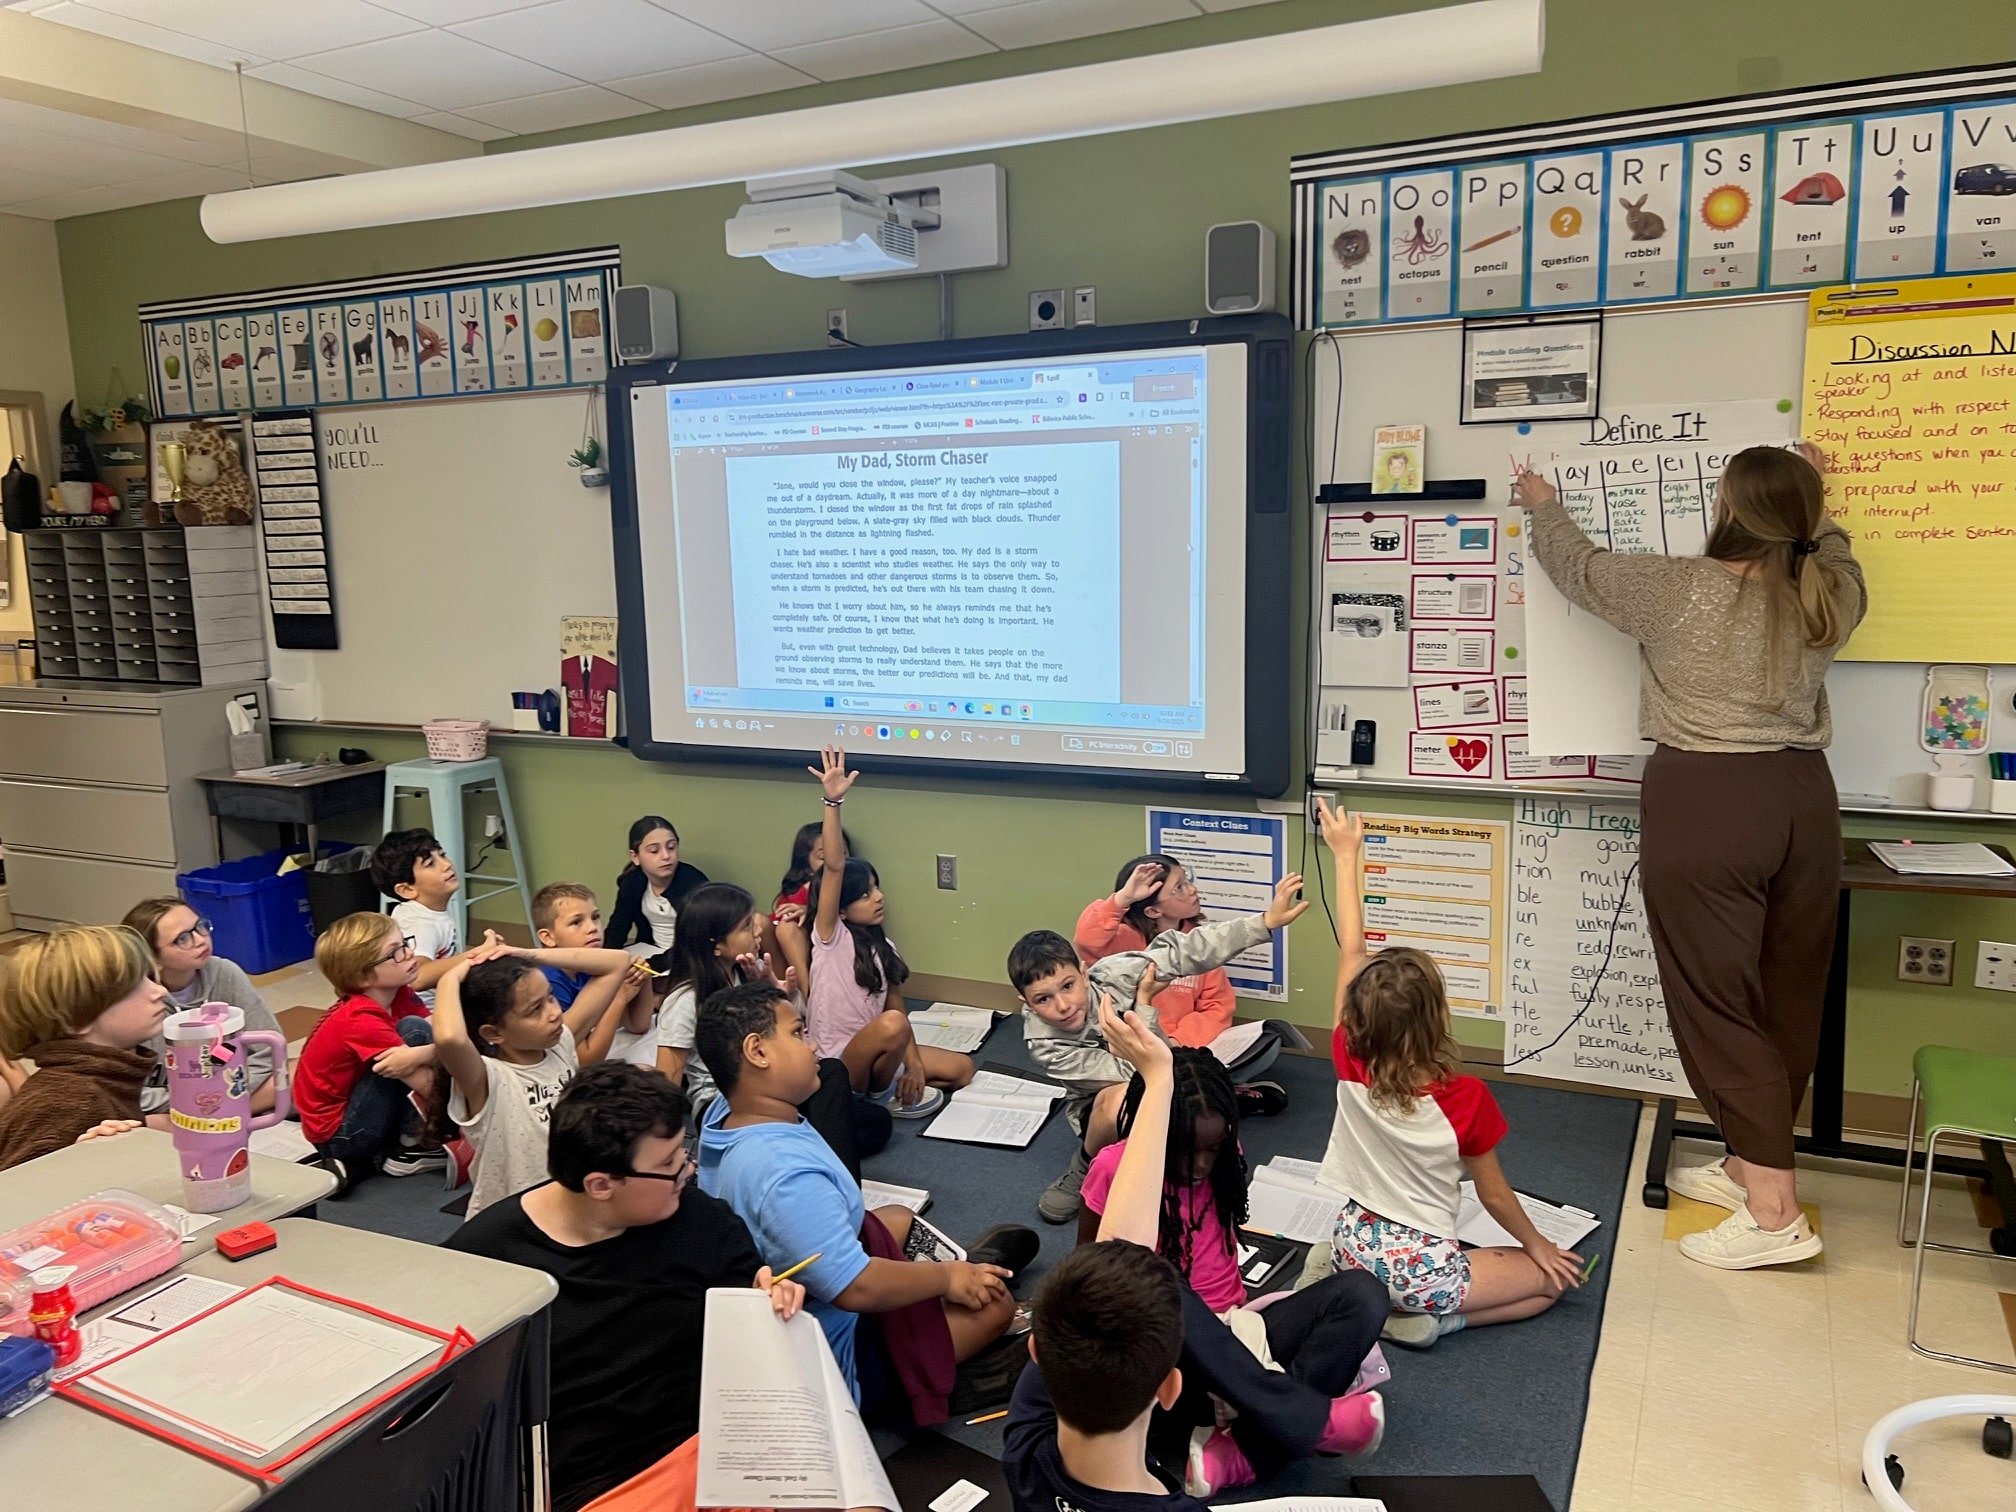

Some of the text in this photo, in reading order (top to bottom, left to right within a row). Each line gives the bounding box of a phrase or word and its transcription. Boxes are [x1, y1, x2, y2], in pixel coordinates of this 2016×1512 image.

[1889, 224, 1906, 234] up
[1976, 216, 2000, 226] van
[1796, 231, 1821, 242] tent
[1624, 247, 1661, 258] rabbit
[1714, 240, 1734, 250] sun
[1474, 262, 1508, 274] pencil
[1541, 254, 1589, 268] question
[1341, 276, 1362, 286] nest
[1399, 269, 1441, 280] octopus
[1849, 335, 1972, 361] Discussion
[1824, 364, 2016, 400] Looking at and liste
[1814, 386, 1870, 403] speaker
[1817, 400, 2011, 428] Responding with respect
[325, 422, 380, 446] YOU'LL
[1588, 412, 1707, 443] Define It
[1814, 429, 1848, 448] Stay
[1856, 425, 1912, 440] focused
[1924, 424, 1958, 437] and
[1970, 426, 1988, 436] on
[836, 449, 989, 473] My Dad, Storm Chaser
[1664, 454, 1684, 471] ei
[1824, 446, 2006, 464] sk questions when you
[772, 473, 1057, 491] "Jane, would you close the window, please?" My teacher's voice snapped
[1566, 465, 1589, 486] ay
[780, 494, 793, 502] out
[795, 493, 804, 502] of
[814, 492, 853, 503] daydream.
[855, 489, 886, 503] Actually,
[890, 491, 896, 500] it
[917, 491, 938, 499] more
[940, 489, 950, 498] of
[961, 488, 976, 499] day
[979, 486, 1050, 499] nightmare—about
[1608, 488, 1648, 498] mistake
[1664, 483, 1689, 498] eight
[1844, 480, 2005, 501] prepared with your
[1566, 492, 1595, 507] today
[1609, 500, 1638, 509] vase
[1612, 508, 1648, 517] make
[1614, 518, 1640, 526] safe
[1332, 531, 1360, 540] rhythm
[1615, 536, 1643, 545] lake
[1864, 530, 1881, 540] in
[1895, 526, 1956, 544] complete
[1416, 642, 1448, 650] stanza
[1420, 698, 1442, 707] lines
[1414, 746, 1442, 754] meter
[1182, 818, 1249, 831] Context Clues
[1522, 799, 1640, 839] High Frequ
[1363, 822, 1492, 840] Reading Big Words Strategy
[1520, 830, 1548, 863] ing
[1596, 838, 1640, 864] goin
[1515, 858, 1640, 894] tion multi
[1518, 884, 1542, 904] ble
[1516, 910, 1538, 926] un
[1516, 932, 1535, 948] re
[1514, 956, 1532, 971] ex
[1511, 975, 1539, 994] ful
[1512, 1000, 1541, 1020] tle
[1514, 1022, 1542, 1038] pre
